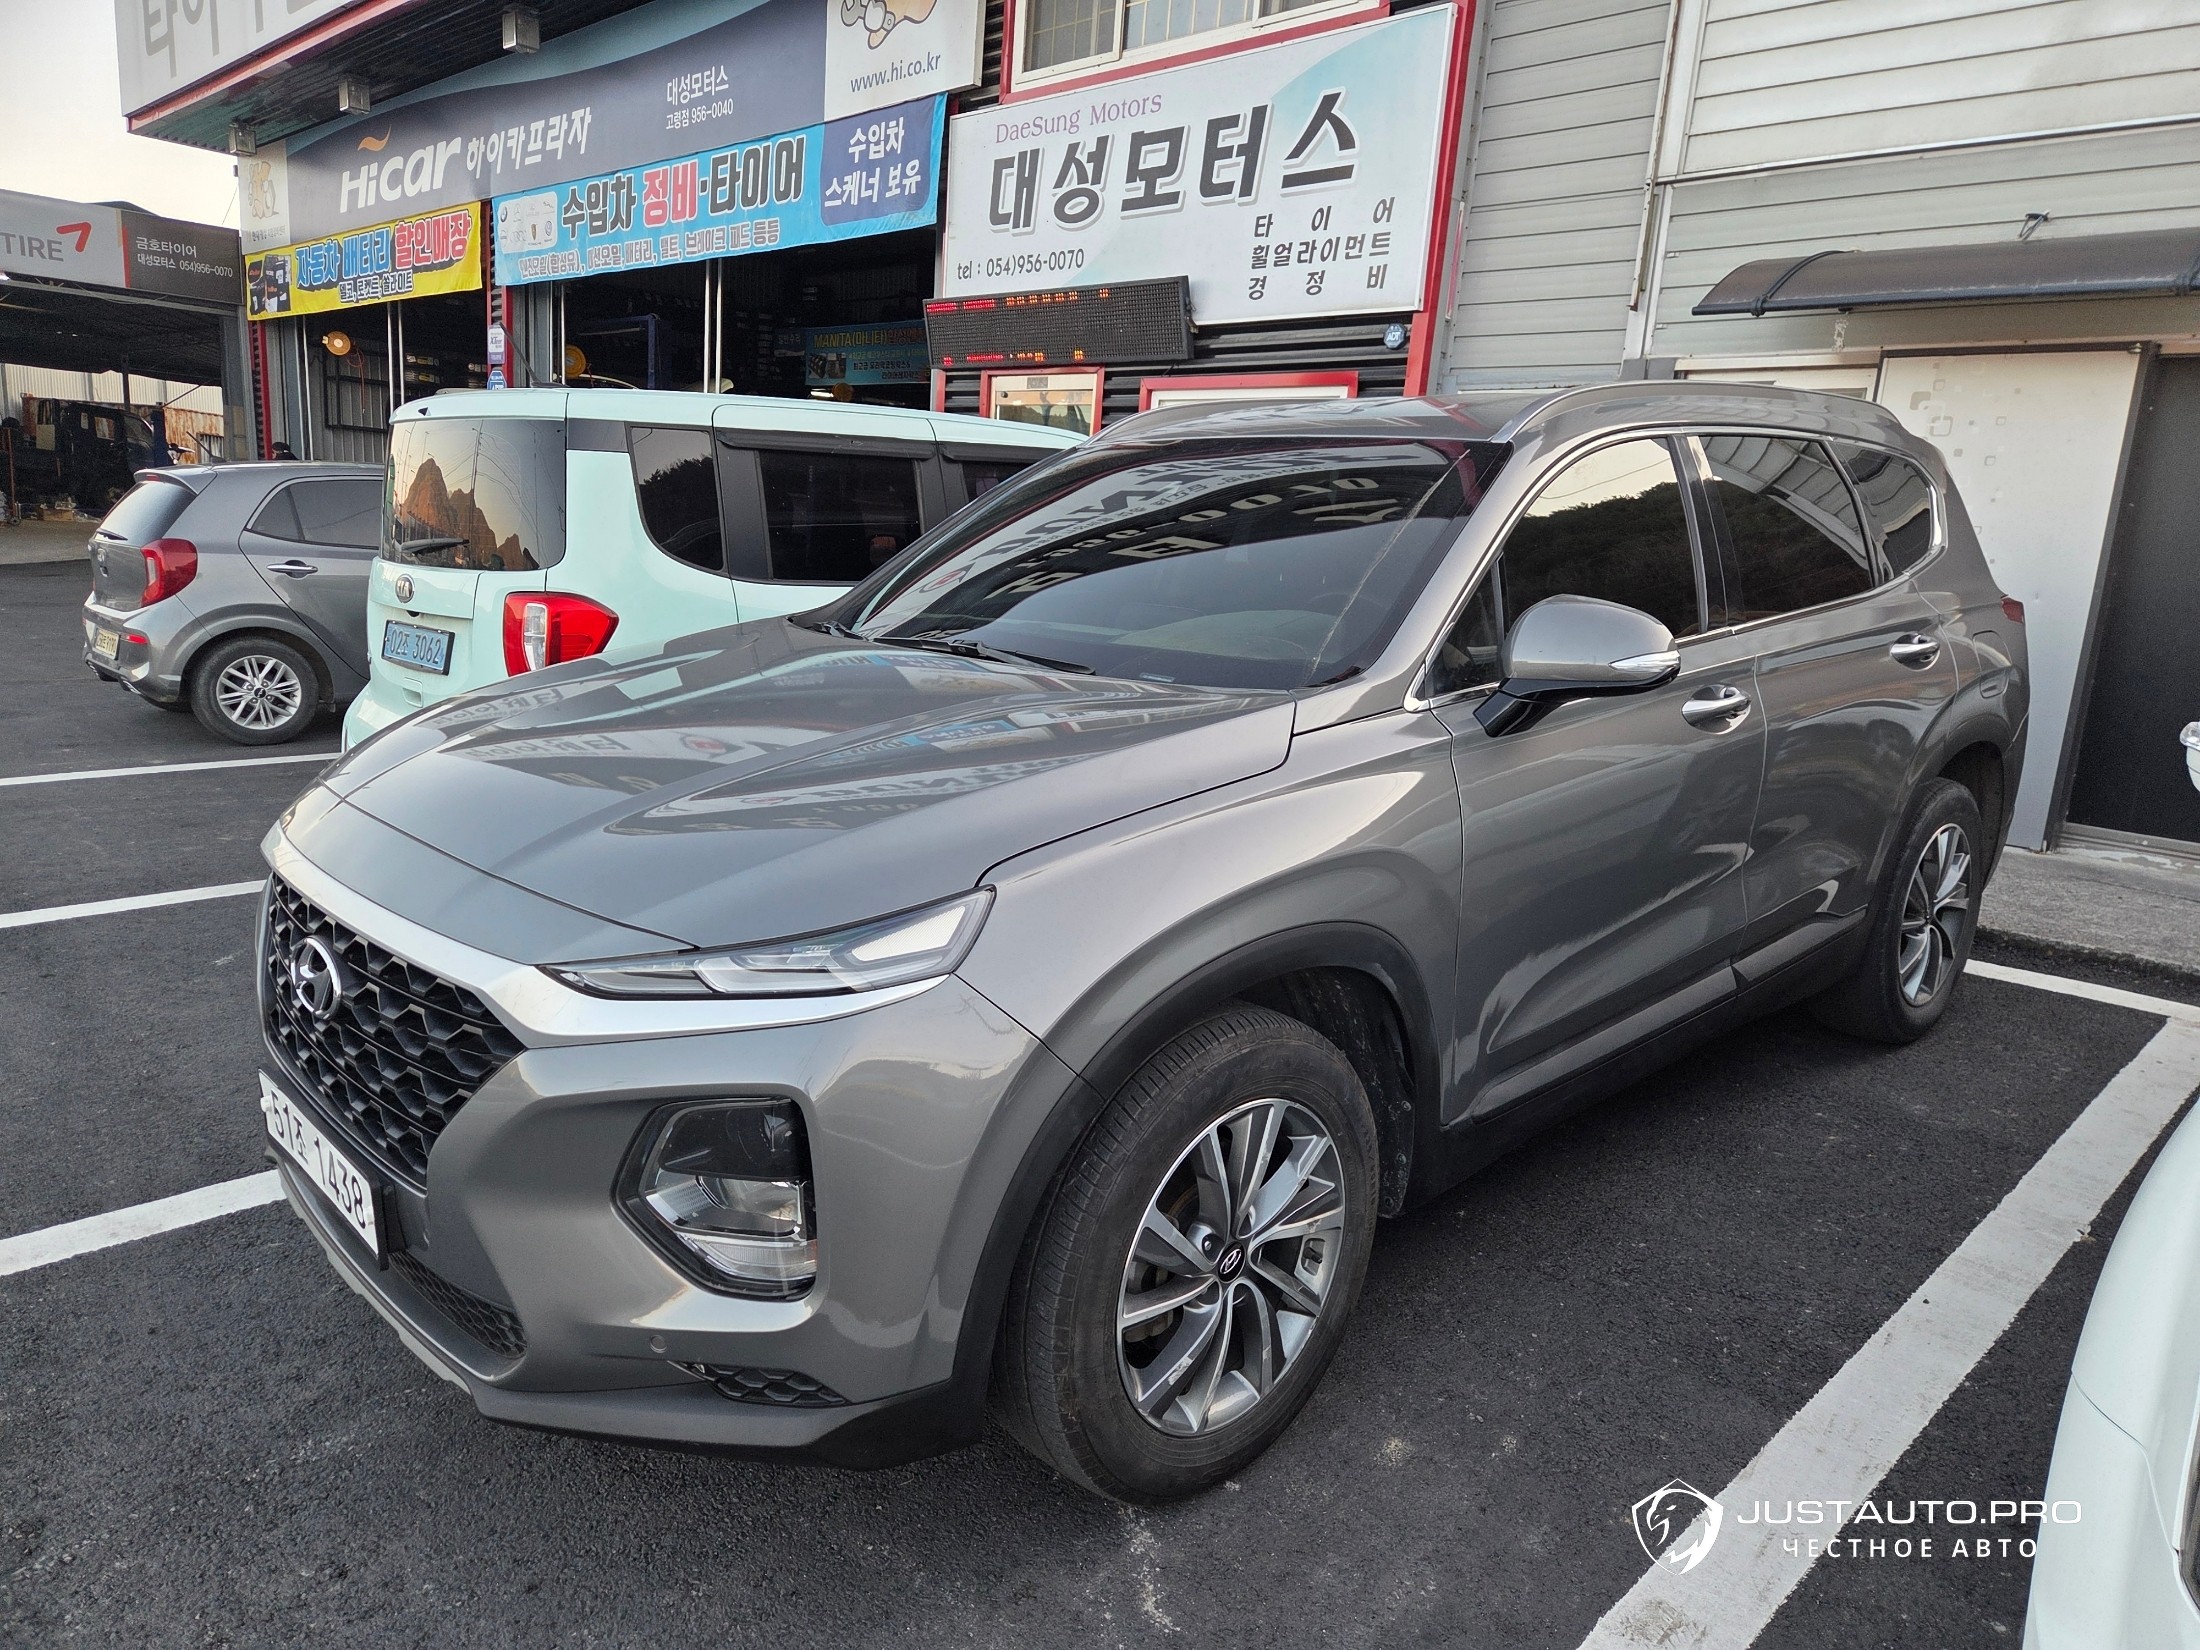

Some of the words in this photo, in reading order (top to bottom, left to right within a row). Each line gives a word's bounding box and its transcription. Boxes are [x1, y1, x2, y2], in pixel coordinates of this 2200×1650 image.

[667, 64, 729, 106] 대성모터스
[850, 52, 941, 92] www.hi.co.kr
[666, 107, 689, 130] 고령점
[691, 98, 734, 123] 956-0040
[996, 109, 1081, 143] DaeSung
[1090, 94, 1162, 125] Motors
[340, 136, 461, 213] Hicar
[466, 106, 592, 179] 하이카프라자
[848, 117, 905, 164] 수입차
[989, 91, 1357, 230] 대성모터스
[825, 167, 880, 207] 스케너
[885, 159, 921, 198] 보유
[562, 173, 637, 239] 수입차
[0, 232, 64, 262] TIRE
[136, 235, 197, 259] 금호타이어
[295, 239, 341, 287] 자동차
[342, 228, 392, 280] 배터리
[394, 209, 472, 270] 할인매장
[685, 226, 727, 257] 브레이크
[753, 217, 780, 246] 등등
[1251, 231, 1391, 269] 휠얼라이먼트
[137, 254, 176, 269] 대성모터스
[179, 260, 233, 278] 054)956-0070
[986, 248, 1085, 277] 054)956-0070
[1386, 331, 1401, 342] ADT
[413, 634, 442, 665] 3062
[313, 1136, 367, 1230] 1438
